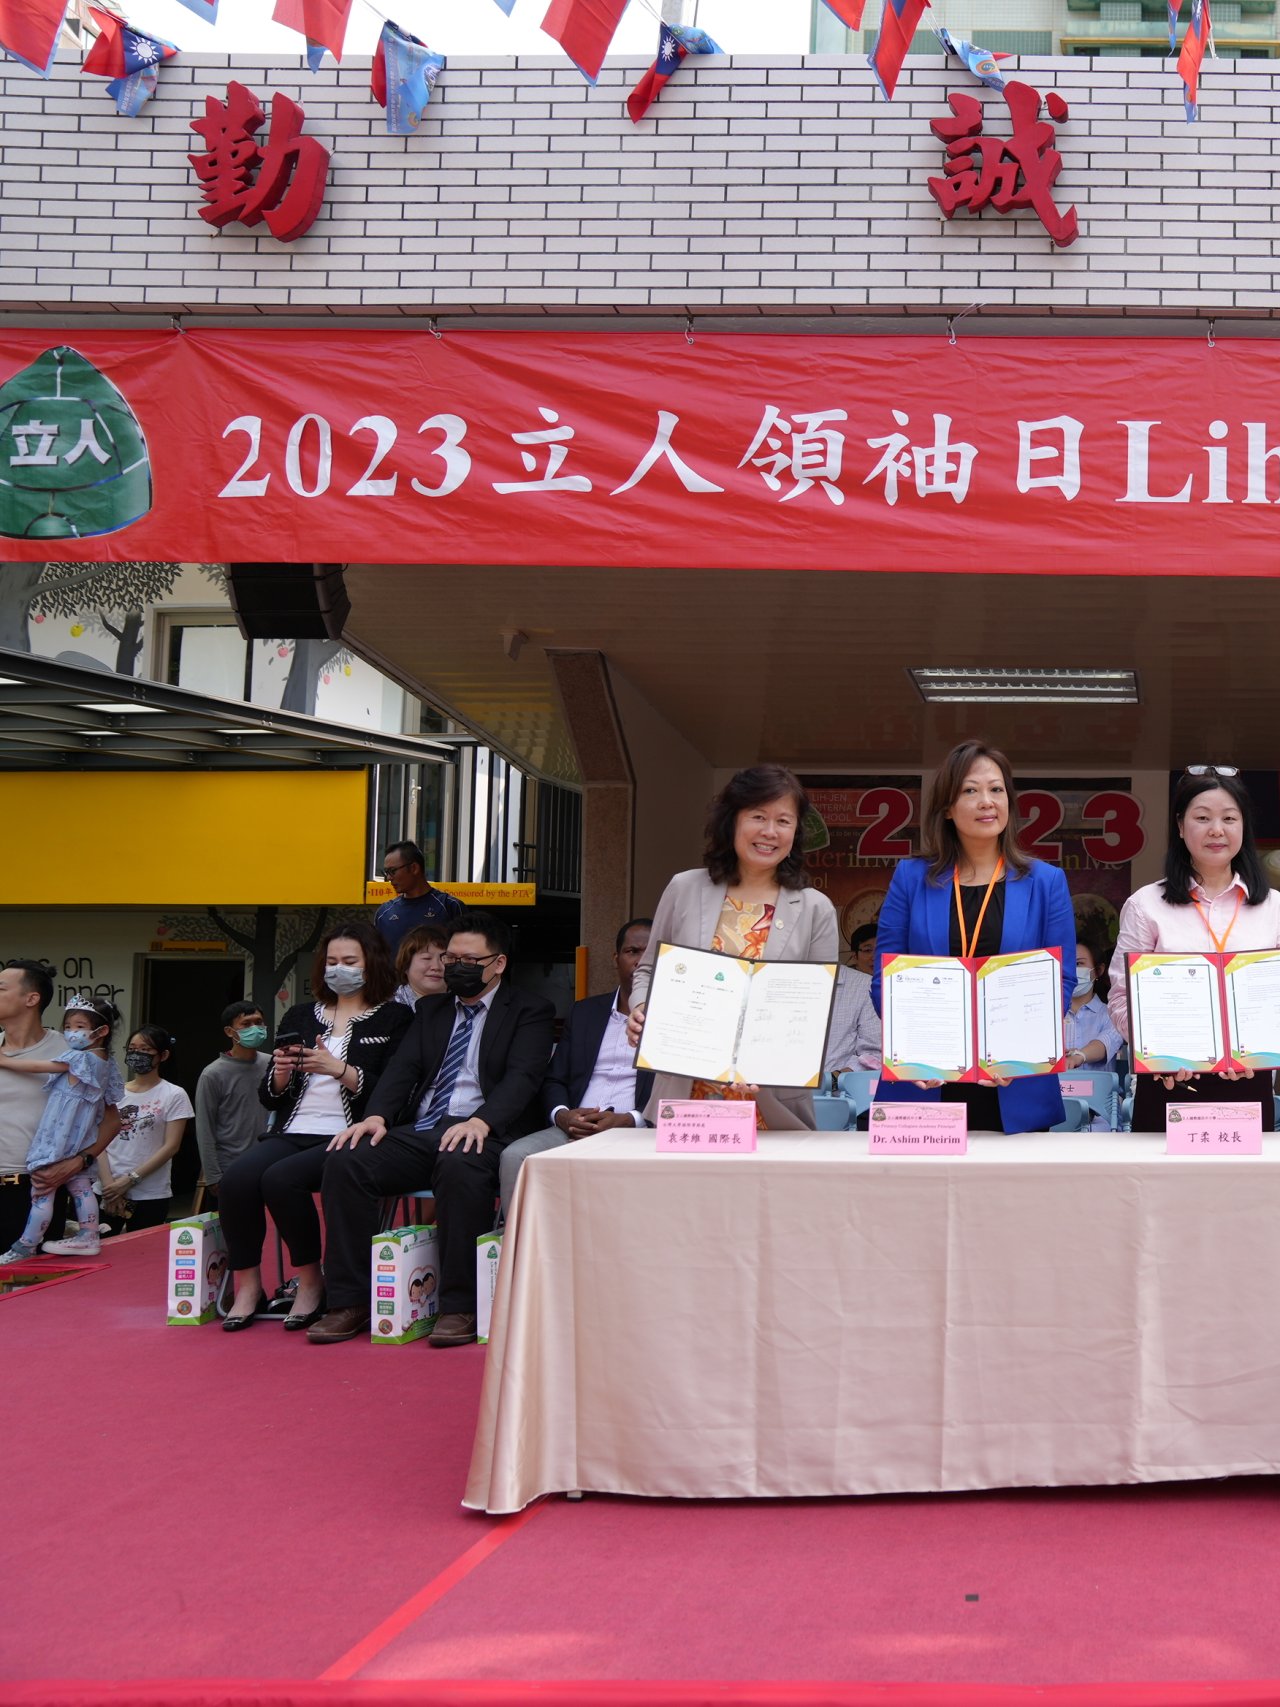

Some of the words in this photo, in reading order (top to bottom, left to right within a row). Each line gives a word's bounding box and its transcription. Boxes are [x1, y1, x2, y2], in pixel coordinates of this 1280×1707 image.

[188, 81, 330, 243] 勤
[928, 81, 1079, 248] 誠
[10, 419, 113, 467] 立人
[486, 888, 496, 899] by
[498, 889, 510, 898] the
[511, 889, 529, 898] PTA
[63, 957, 93, 979] on
[708, 1133, 742, 1144] 國際長
[873, 1135, 888, 1144] Dr.
[889, 1135, 920, 1144] Ashim
[923, 1135, 960, 1144] Pheirim
[1187, 1131, 1210, 1143] 丁柔
[1218, 1131, 1242, 1143] 校長
